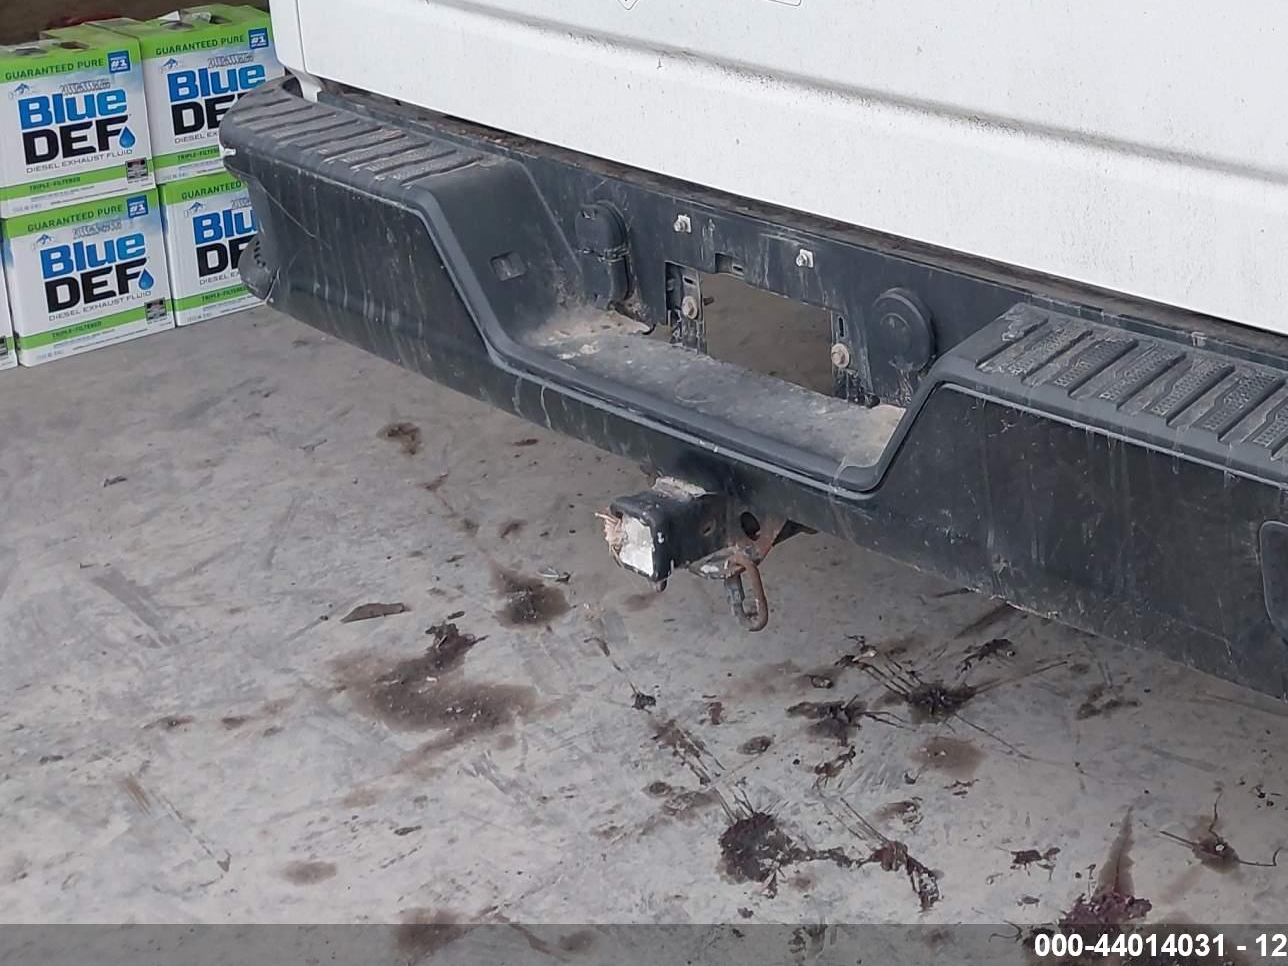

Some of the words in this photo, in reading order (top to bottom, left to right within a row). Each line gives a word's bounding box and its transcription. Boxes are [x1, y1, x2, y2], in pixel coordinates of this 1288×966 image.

[155, 39, 218, 56] GUARANTEED
[220, 34, 245, 46] PURE
[5, 62, 74, 81] GUARANTEED
[77, 58, 105, 71] PURE
[167, 64, 266, 103] Blue
[18, 89, 128, 131] Blue
[22, 115, 129, 166] DEF
[174, 135, 205, 145] DIESEL
[26, 163, 62, 174] DIESEL
[61, 154, 105, 168] EXHAUST
[106, 149, 133, 159] FLUID
[181, 181, 242, 201] GUARANTEED
[27, 212, 95, 233] GUARANTEED
[97, 204, 124, 217] PURE
[192, 209, 258, 245] Blu
[40, 233, 146, 280] Blue
[45, 258, 148, 314] DEF
[200, 274, 229, 285] DIESEL
[49, 309, 81, 322] DIESEL
[83, 299, 125, 313] EXHAUST
[126, 291, 152, 302] FLUID
